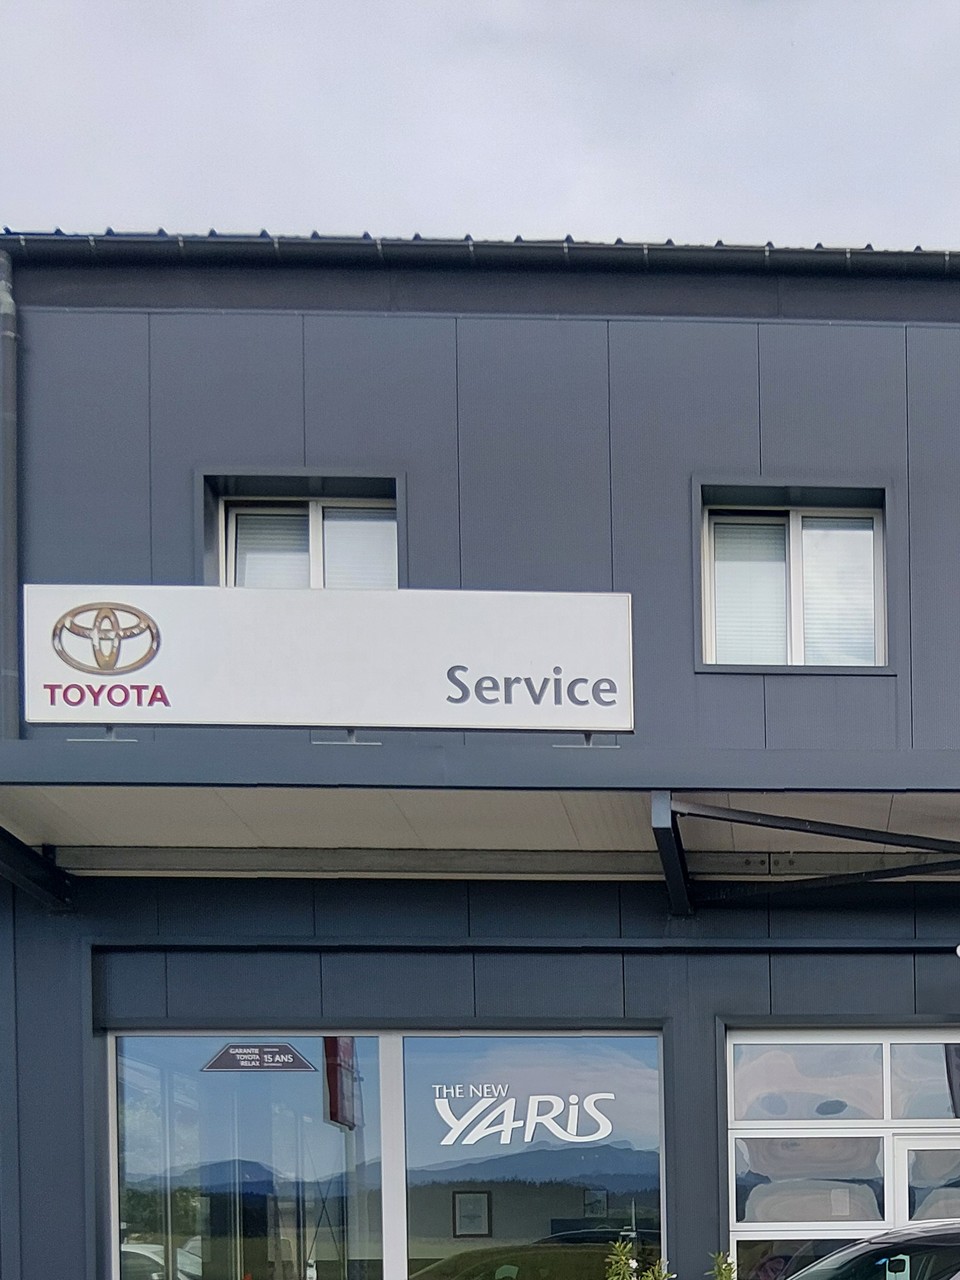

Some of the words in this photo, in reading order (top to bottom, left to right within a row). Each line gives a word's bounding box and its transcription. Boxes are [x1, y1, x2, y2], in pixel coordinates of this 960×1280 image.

[445, 664, 618, 707] Service
[43, 683, 171, 709] TOYOTA
[263, 1054, 273, 1063] 15
[274, 1054, 294, 1063] ANS
[431, 1084, 465, 1098] THE
[469, 1084, 509, 1097] NEW
